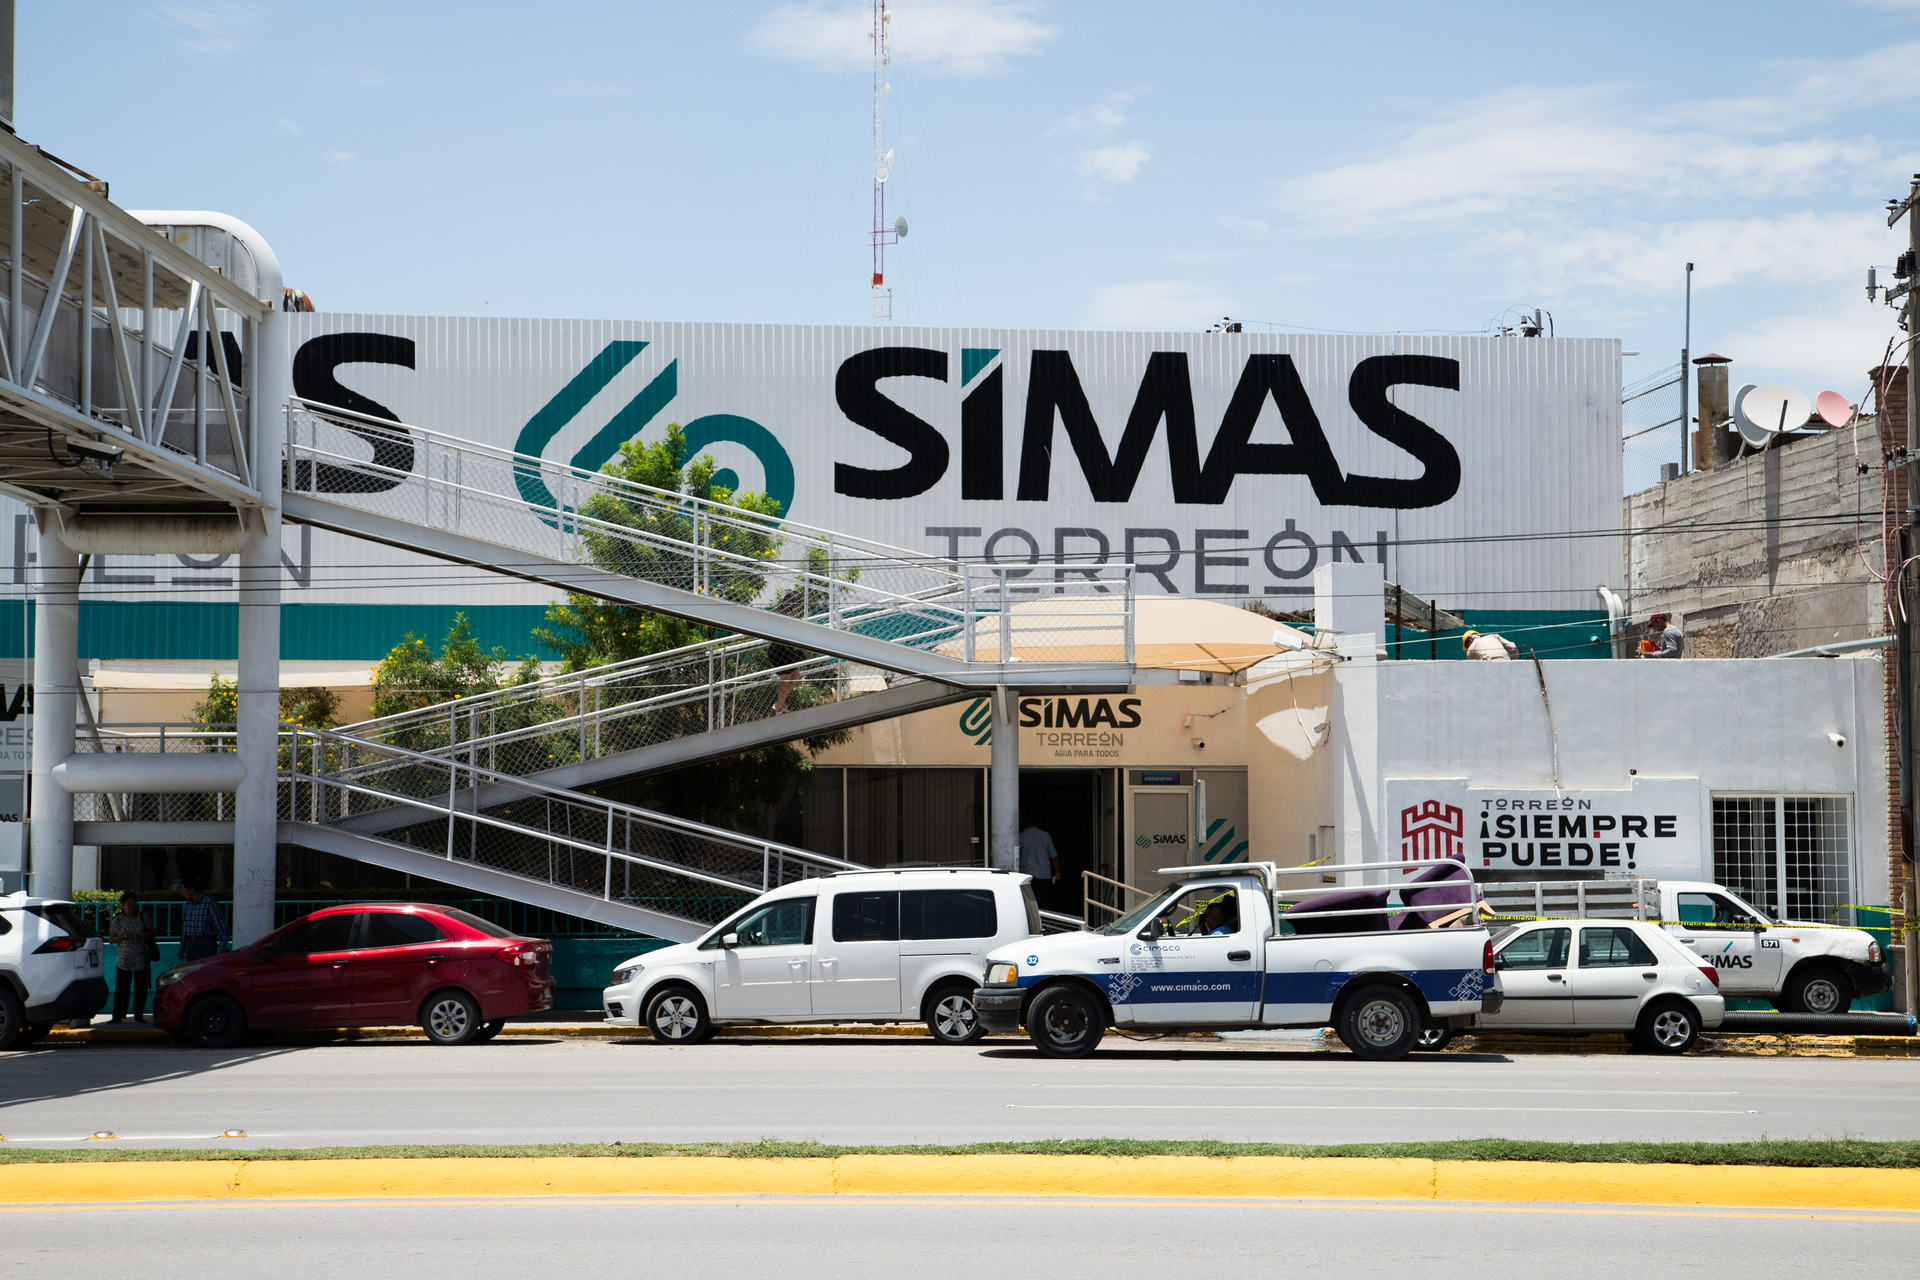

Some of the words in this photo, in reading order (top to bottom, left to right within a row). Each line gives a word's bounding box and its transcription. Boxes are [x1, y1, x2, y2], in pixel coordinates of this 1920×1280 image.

[834, 347, 1461, 509] SIMAS
[1019, 698, 1142, 728] SIMAS
[1036, 731, 1124, 747] TORREÓN
[1481, 796, 1591, 810] TORREÓN
[1479, 811, 1677, 838] ¡SIEMPRE
[1153, 834, 1186, 844] SIMAS
[1483, 842, 1636, 869] PUEDE!
[1763, 940, 1778, 948] 871
[1027, 956, 1038, 964] 32
[1150, 983, 1231, 992] www.cimaco.com
